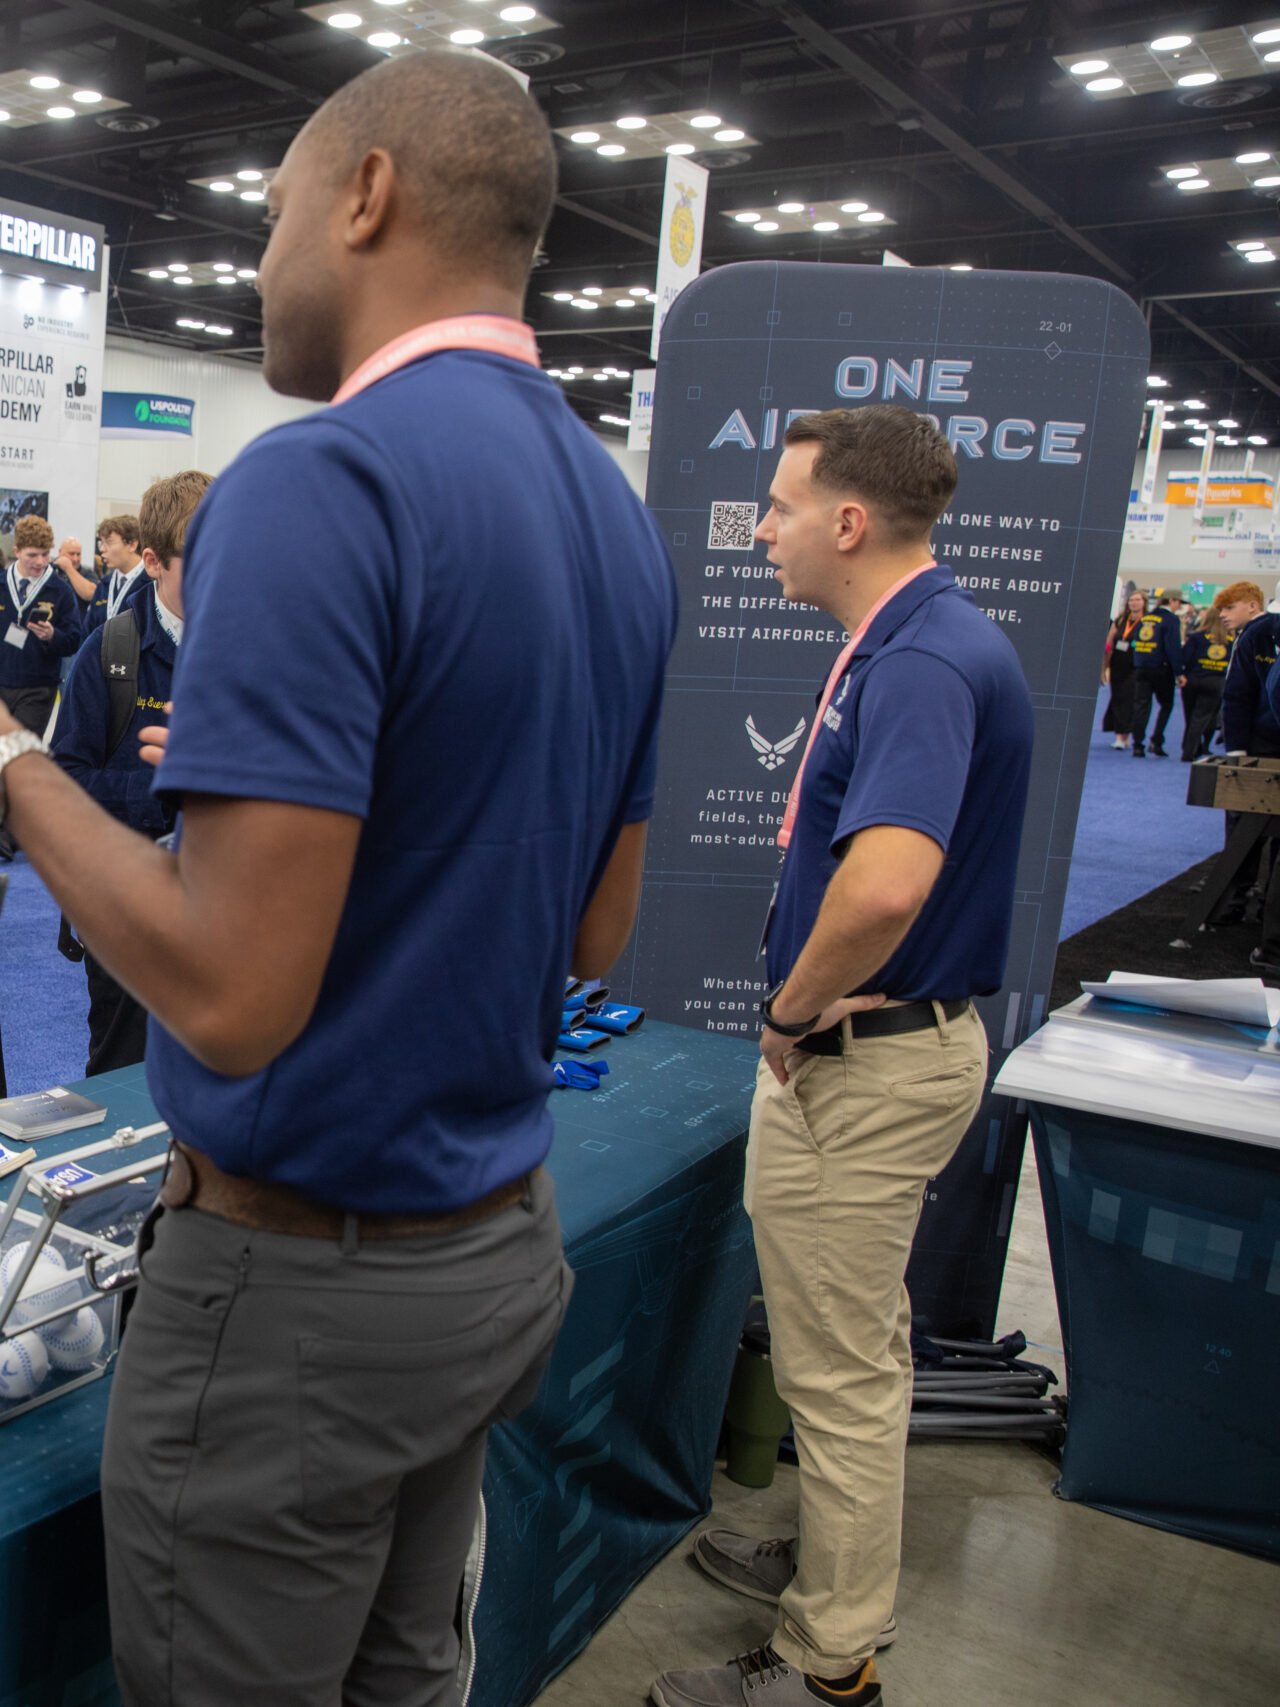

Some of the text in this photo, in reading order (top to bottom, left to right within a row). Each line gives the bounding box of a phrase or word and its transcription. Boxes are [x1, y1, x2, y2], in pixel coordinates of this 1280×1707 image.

[835, 356, 973, 402] ONE
[960, 513, 1061, 532] ONE WAY TO
[943, 544, 962, 557] IN
[969, 545, 1043, 562] DEFENSE
[705, 565, 1062, 594] OF YOUR MORE ABOUT
[702, 596, 732, 608] THE
[698, 626, 746, 639] VISIT
[706, 789, 764, 803] ACTIVE
[698, 810, 751, 825] fields,
[703, 977, 768, 991] Whether
[684, 1000, 711, 1011] you
[718, 1001, 745, 1010] can
[707, 1019, 748, 1031] home
